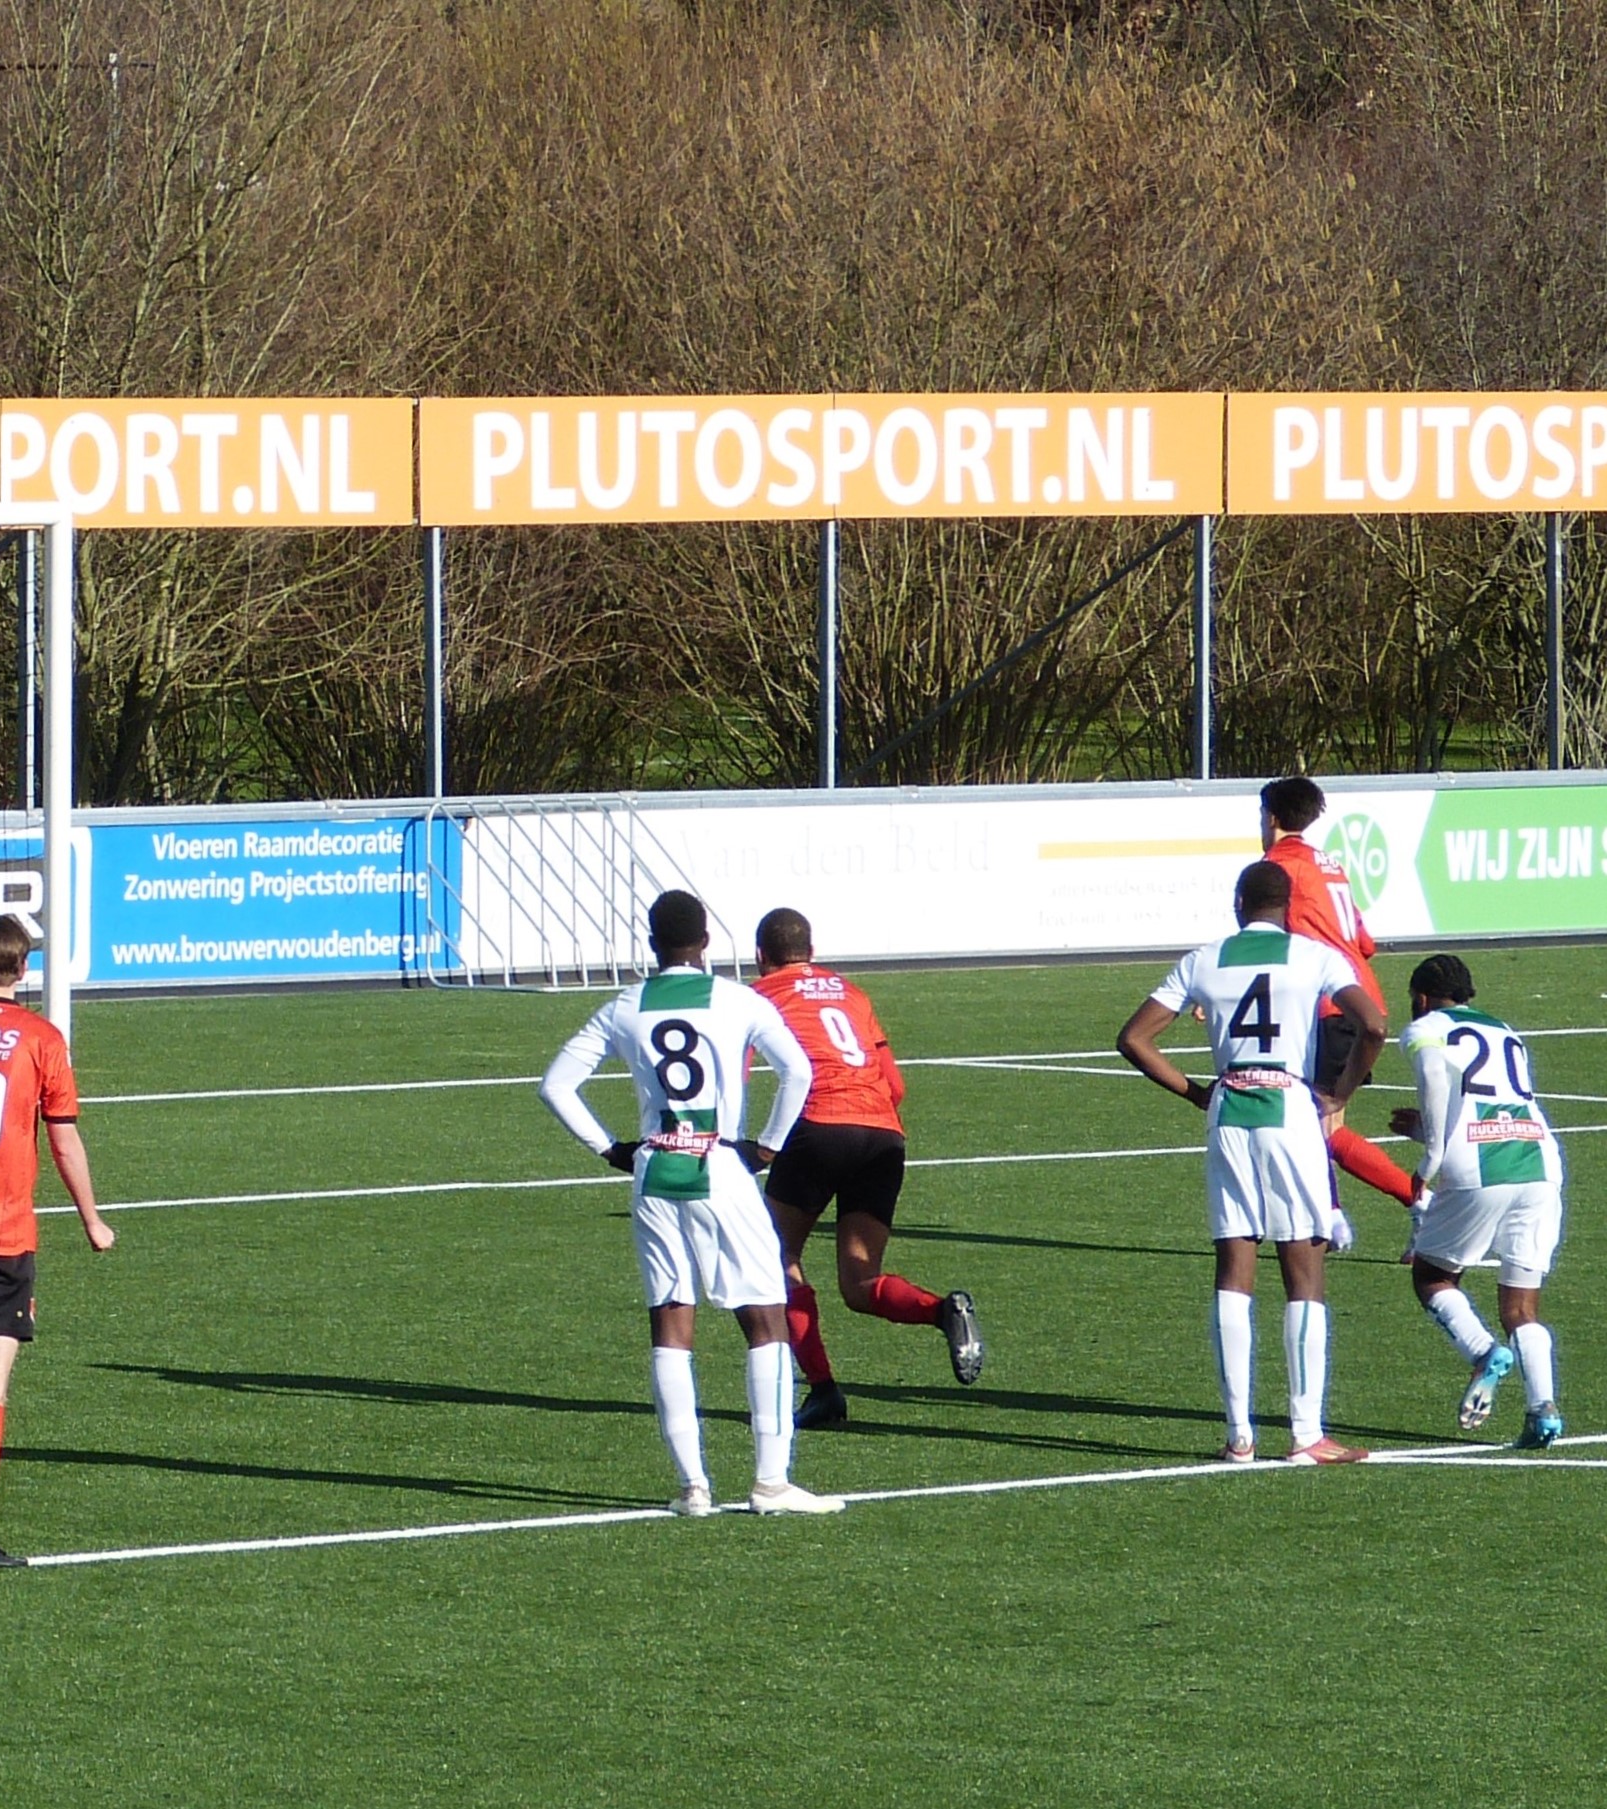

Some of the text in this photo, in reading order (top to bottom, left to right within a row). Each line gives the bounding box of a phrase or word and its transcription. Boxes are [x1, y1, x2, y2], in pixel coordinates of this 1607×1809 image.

[473, 407, 1175, 510] PLUTOSPORT.NL
[153, 827, 404, 861] Vloeren Raamdecoratie
[1444, 828, 1509, 882] WIJ
[1516, 826, 1592, 880] ZIJN
[124, 865, 428, 905] Zonwering Projectstoffering
[112, 929, 442, 964] www.brouwerwoudenberg.nl
[794, 976, 844, 992] AFAS
[1228, 972, 1281, 1054] 4
[650, 1018, 705, 1102] 8
[819, 1006, 866, 1067] 9
[1446, 1027, 1534, 1101] 20
